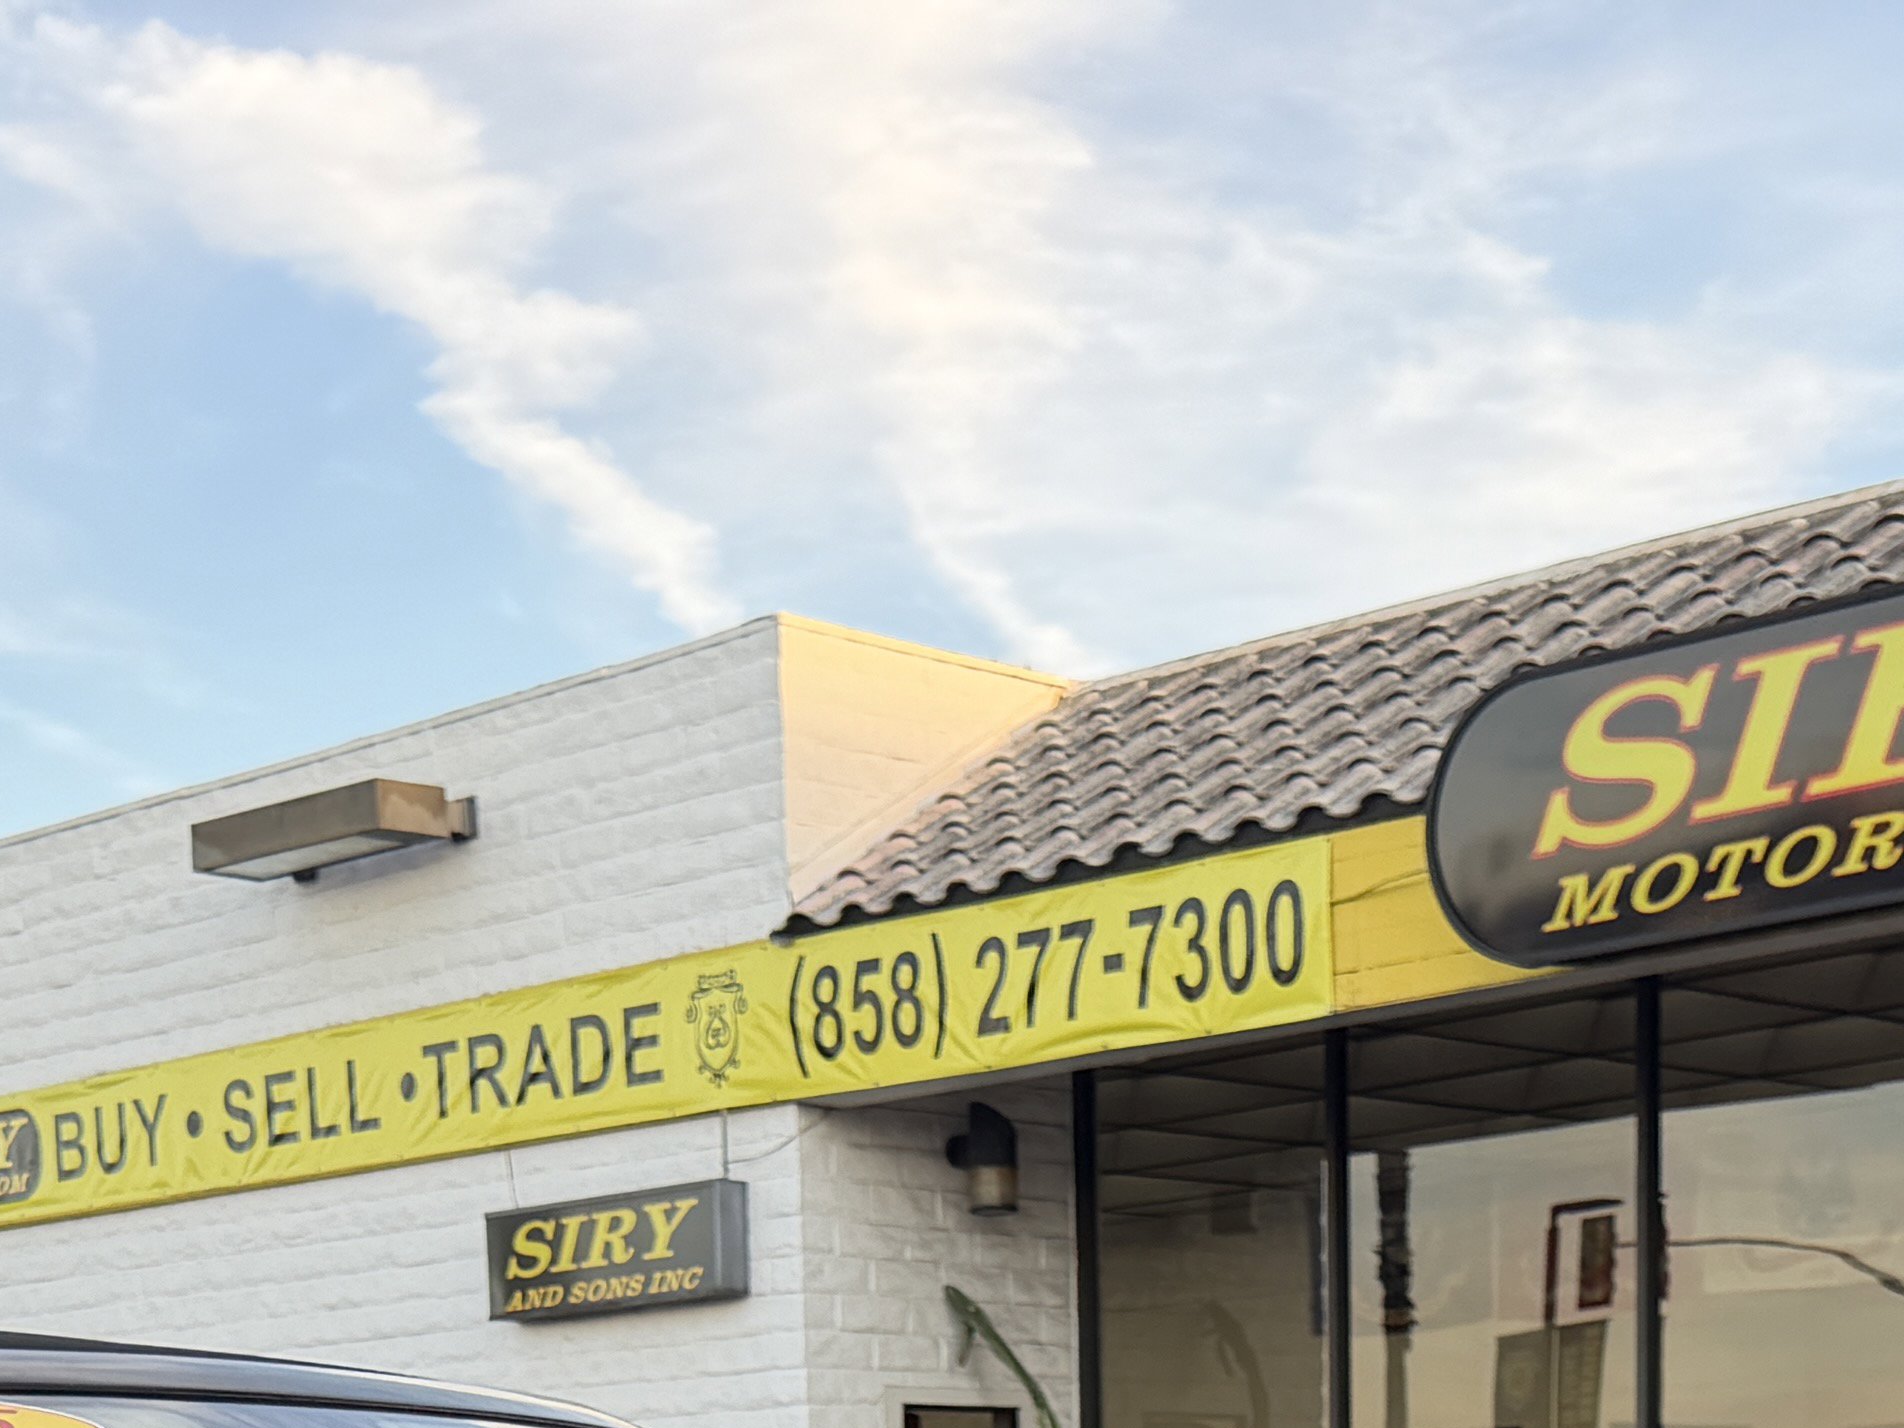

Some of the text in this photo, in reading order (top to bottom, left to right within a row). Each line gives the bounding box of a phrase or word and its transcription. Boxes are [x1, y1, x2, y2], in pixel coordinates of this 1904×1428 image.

[788, 878, 1306, 1078] (858) 277-7300
[55, 1001, 665, 1183] BUY SELL TRADE
[504, 1266, 705, 1314] AND SONS INC
[506, 1197, 699, 1281] SIRY
